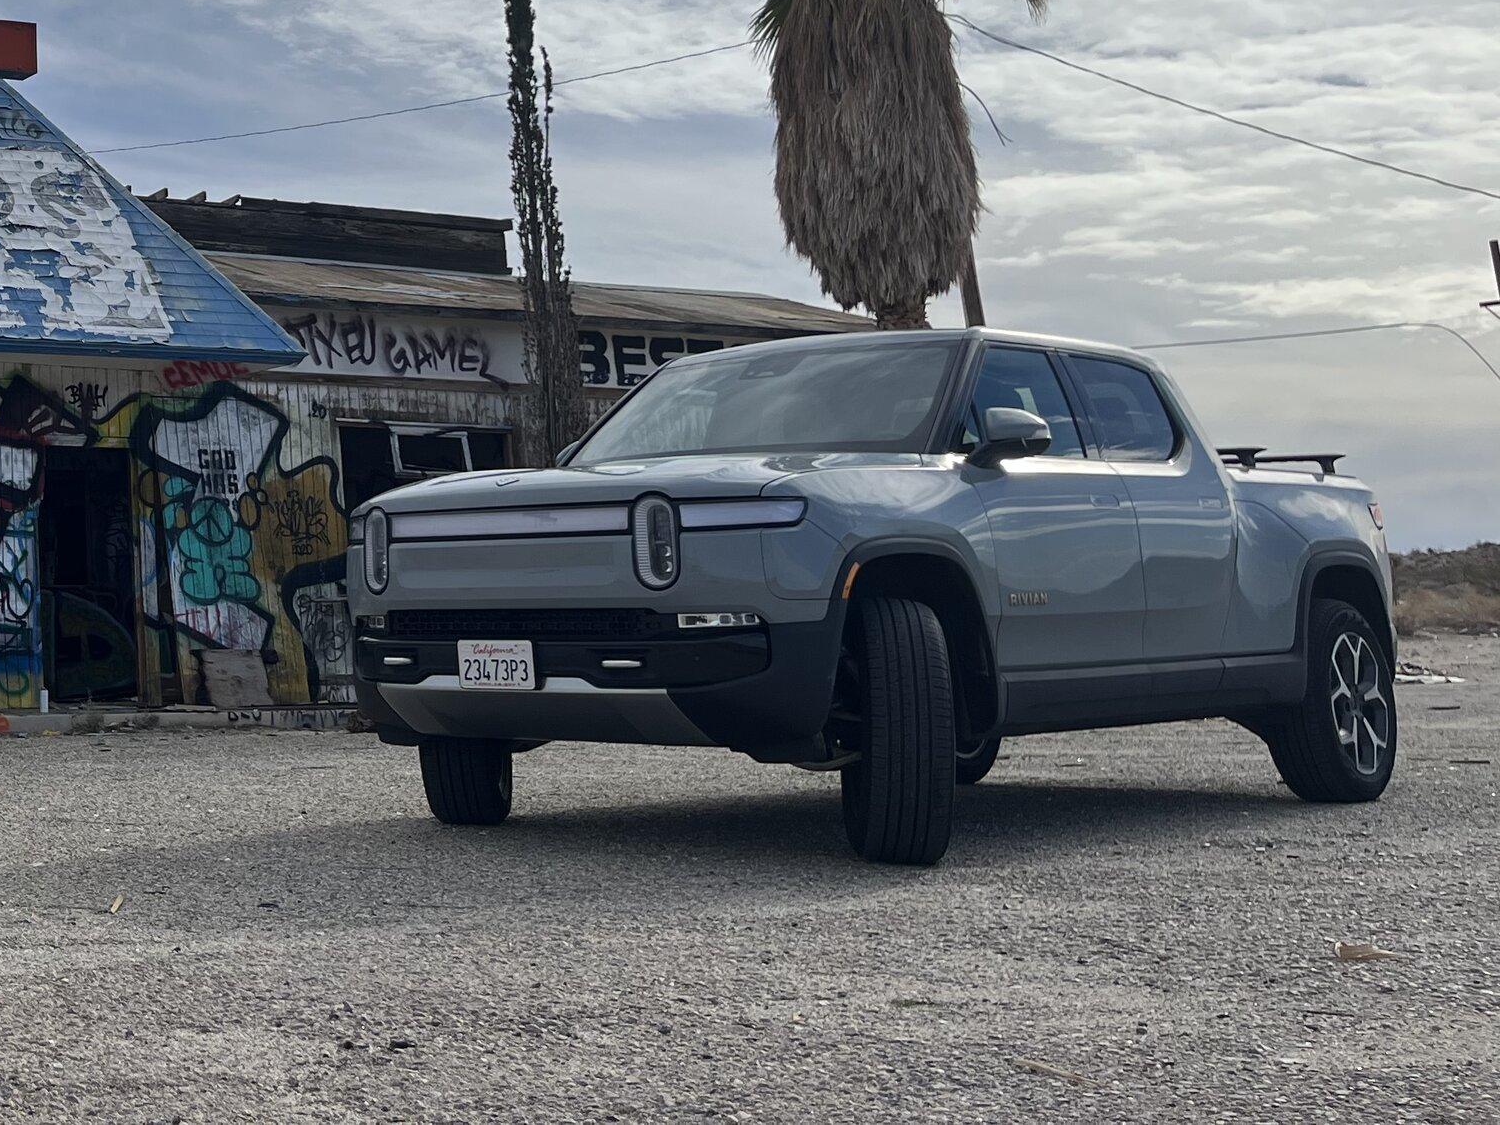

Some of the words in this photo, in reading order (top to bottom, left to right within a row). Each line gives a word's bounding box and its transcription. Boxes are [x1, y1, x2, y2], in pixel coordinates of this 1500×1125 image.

[577, 330, 724, 386] BES
[197, 449, 237, 470] GOD
[1009, 591, 1049, 606] RIVIAN
[463, 658, 529, 682] 23473P3
